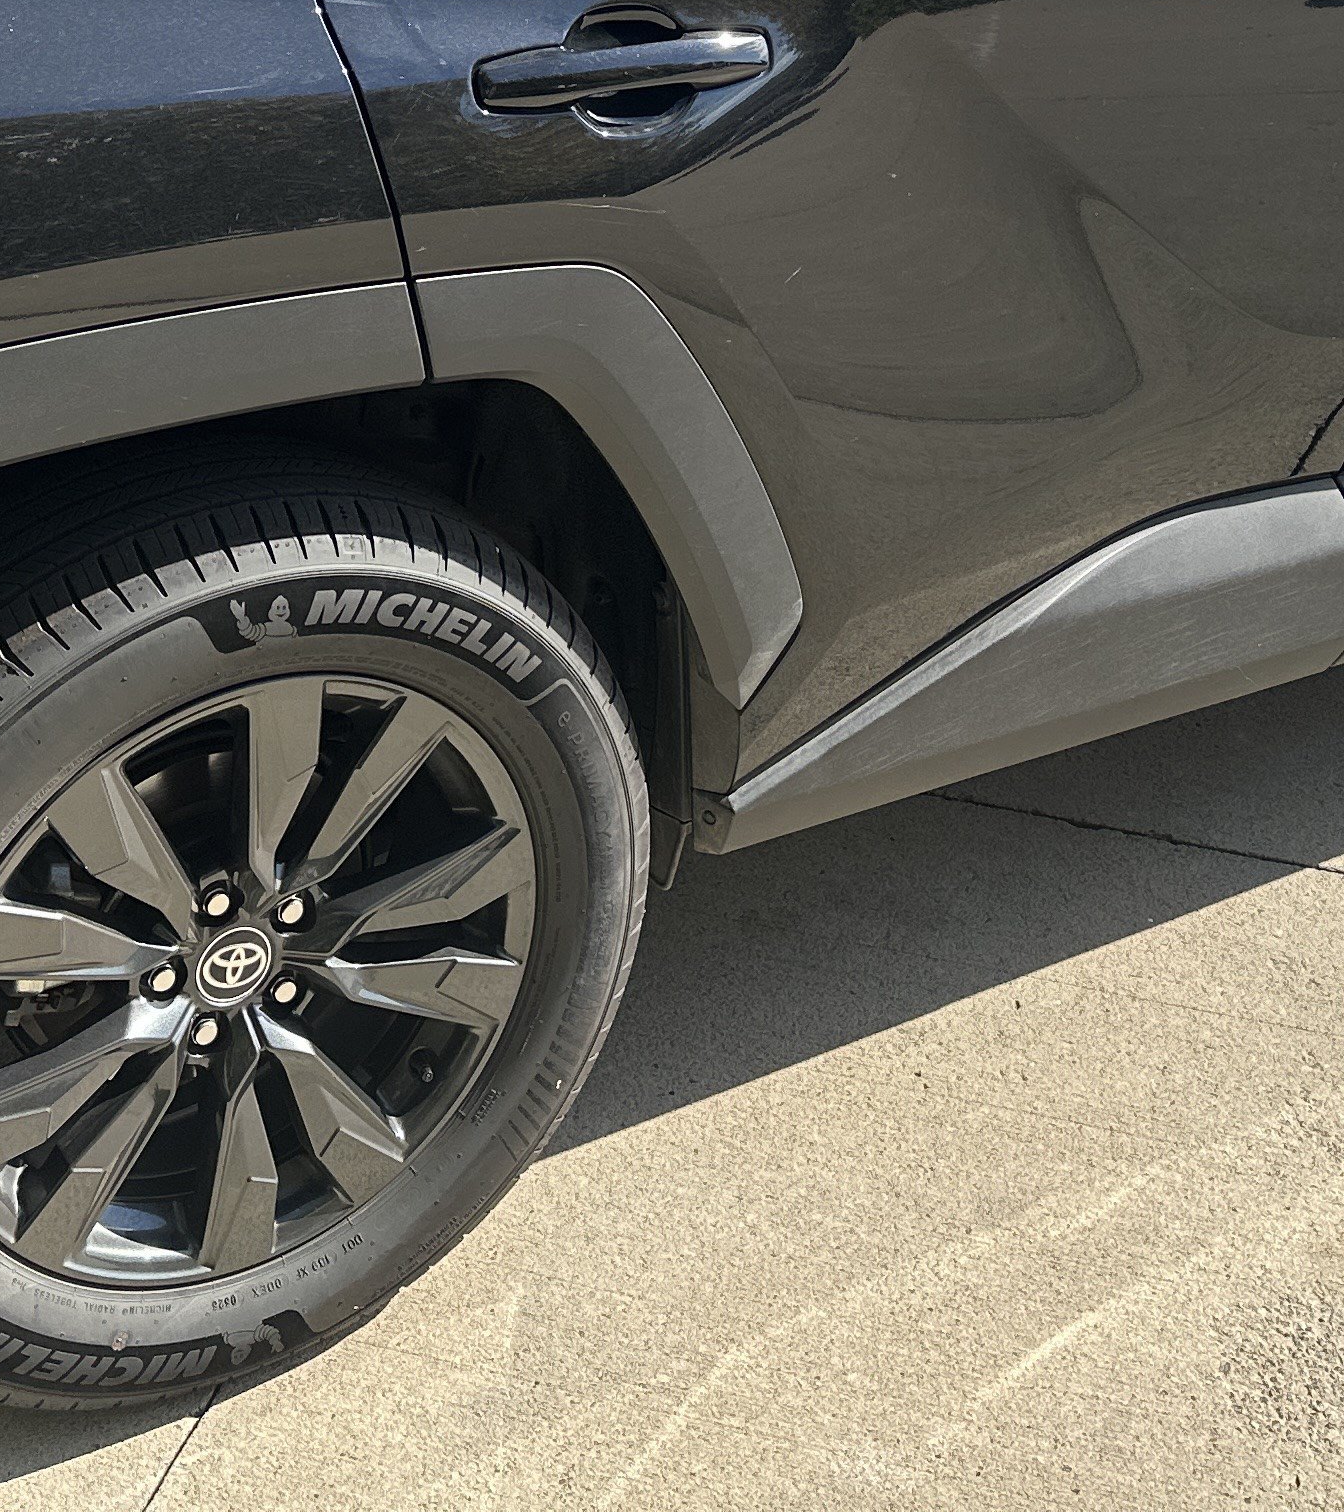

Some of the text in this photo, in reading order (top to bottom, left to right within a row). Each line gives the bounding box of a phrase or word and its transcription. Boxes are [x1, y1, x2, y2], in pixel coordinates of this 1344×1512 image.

[304, 589, 543, 683] MICHELIN
[341, 1234, 363, 1256] DOT
[34, 1288, 77, 1310] TUBELESS
[84, 1301, 116, 1315] RADIAL
